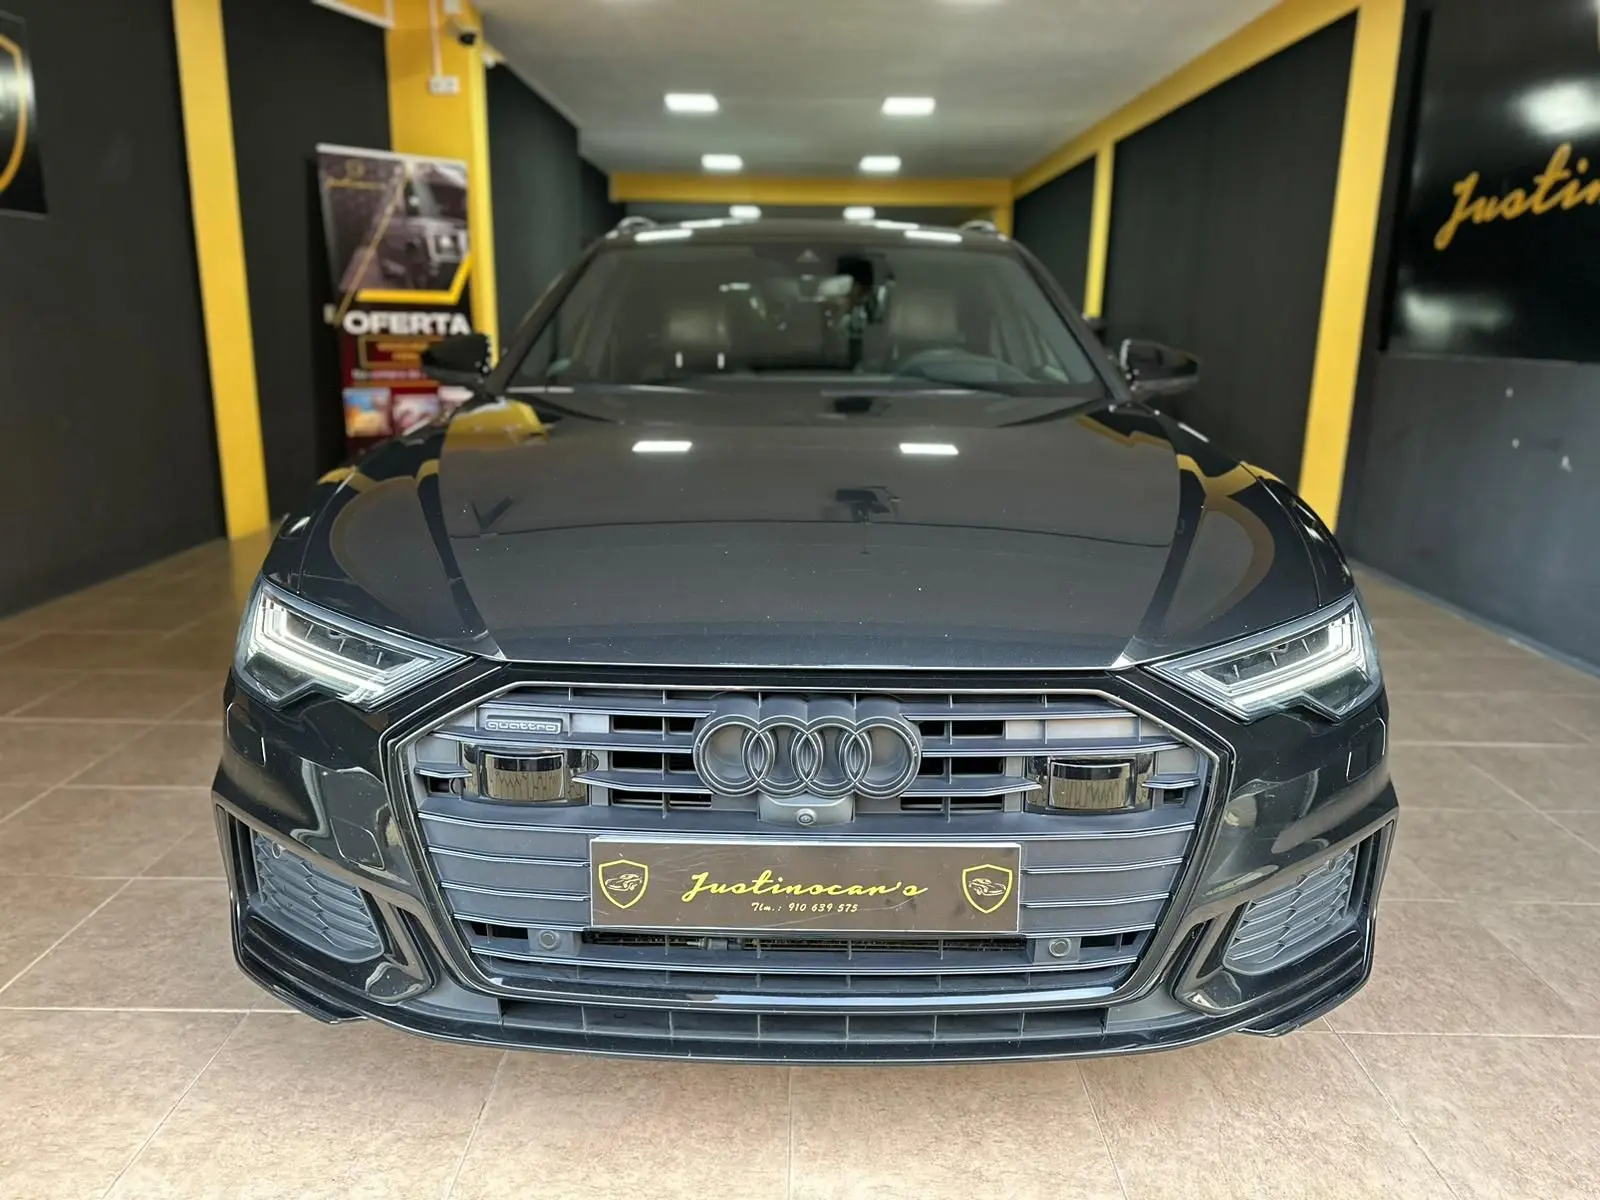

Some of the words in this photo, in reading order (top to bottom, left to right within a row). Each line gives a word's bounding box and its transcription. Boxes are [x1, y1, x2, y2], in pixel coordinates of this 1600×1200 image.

[343, 311, 470, 335] OFERTA
[487, 720, 557, 731] quattro
[788, 903, 807, 912] 910
[811, 904, 833, 912] 639
[837, 904, 859, 913] 575
